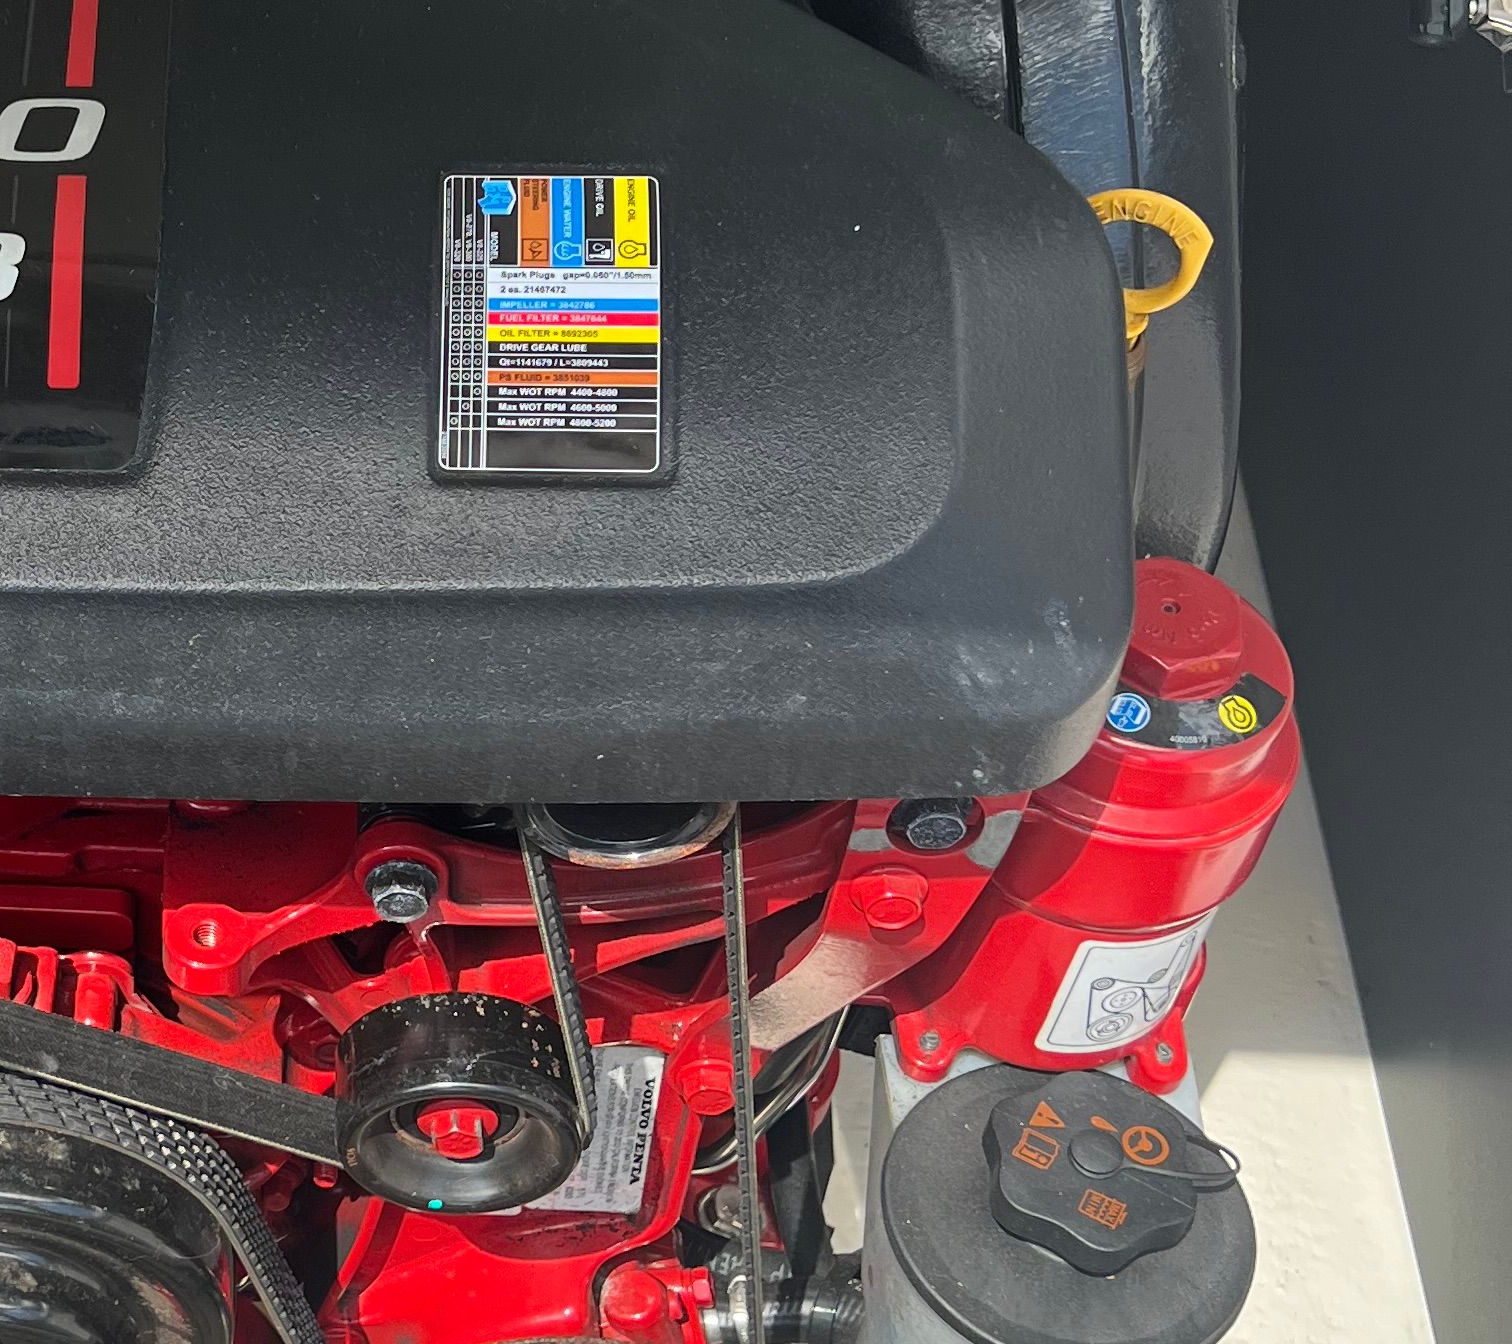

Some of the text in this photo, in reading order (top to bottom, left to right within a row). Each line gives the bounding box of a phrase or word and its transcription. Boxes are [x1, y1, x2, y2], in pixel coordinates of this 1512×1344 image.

[595, 179, 604, 217] DRIVE OIL
[563, 179, 572, 238] ENGINE WATER
[1091, 198, 1198, 249] ENGINE
[499, 314, 524, 322] FUEL
[527, 314, 559, 322] FILTER
[531, 344, 559, 352] GEAR
[561, 344, 587, 352] LUBE
[498, 388, 518, 396] Max
[519, 388, 542, 396] WOT
[545, 388, 566, 396] RPM
[498, 403, 517, 411] Max
[519, 403, 542, 411] WOT
[545, 403, 566, 411] RPM
[497, 418, 517, 426] Max
[518, 418, 541, 426] WOT
[543, 418, 566, 426] RPM
[630, 1078, 658, 1185] VOLVO PENTA
